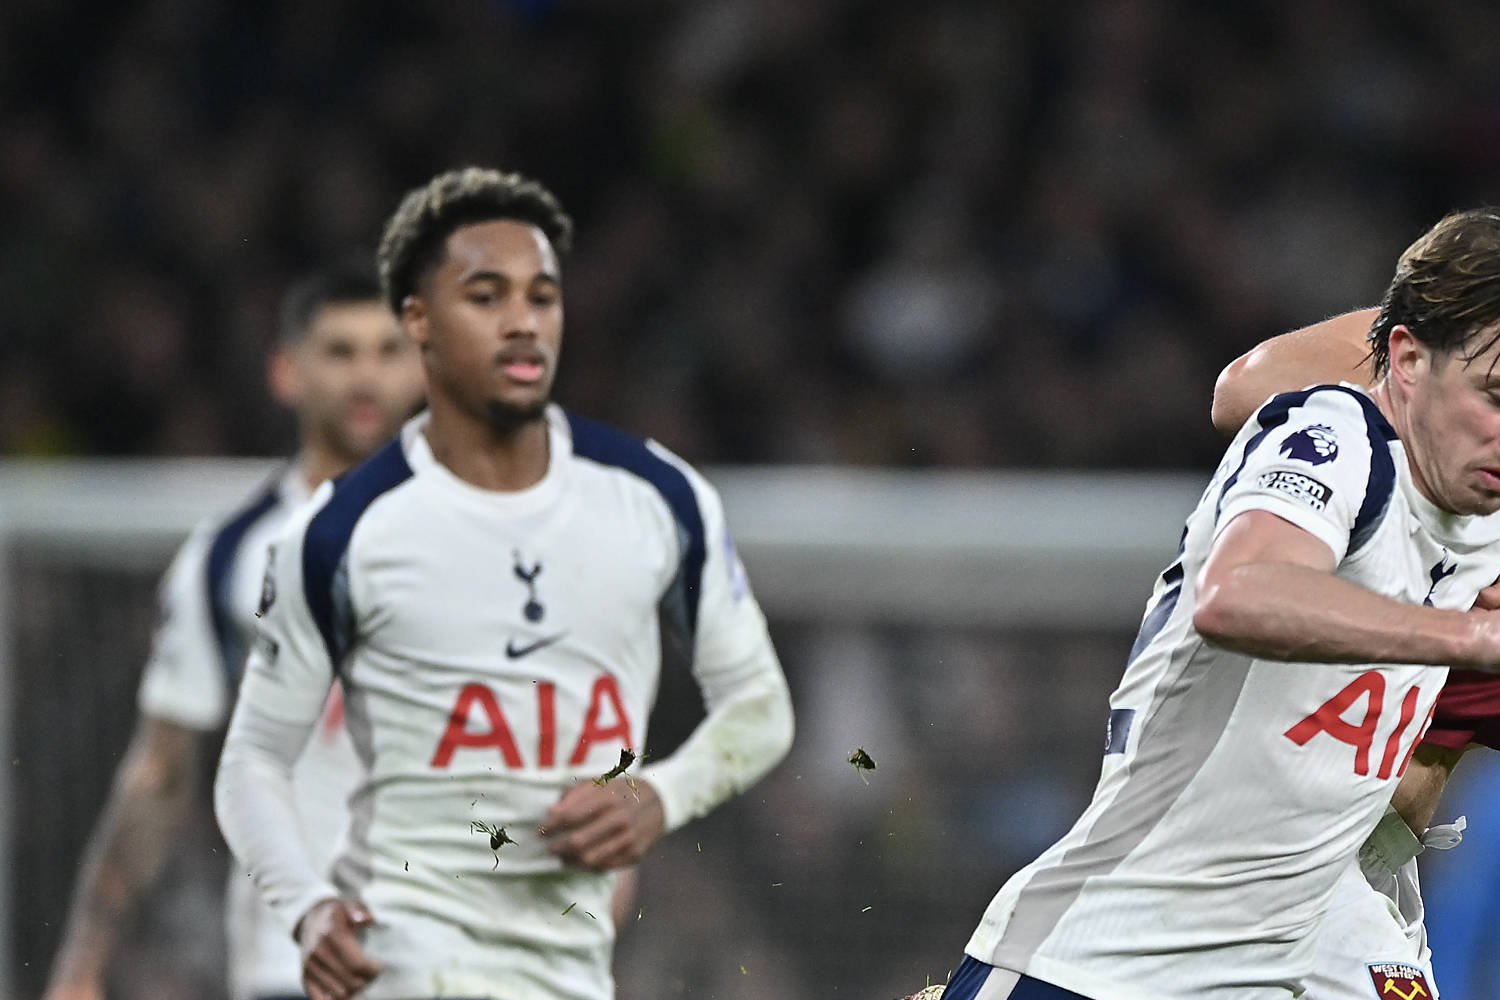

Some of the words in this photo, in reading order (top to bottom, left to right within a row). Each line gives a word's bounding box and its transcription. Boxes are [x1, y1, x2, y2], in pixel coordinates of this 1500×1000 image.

[430, 673, 634, 769] AIA
[1371, 963, 1398, 974] WEST
[1399, 964, 1423, 978] HAM
